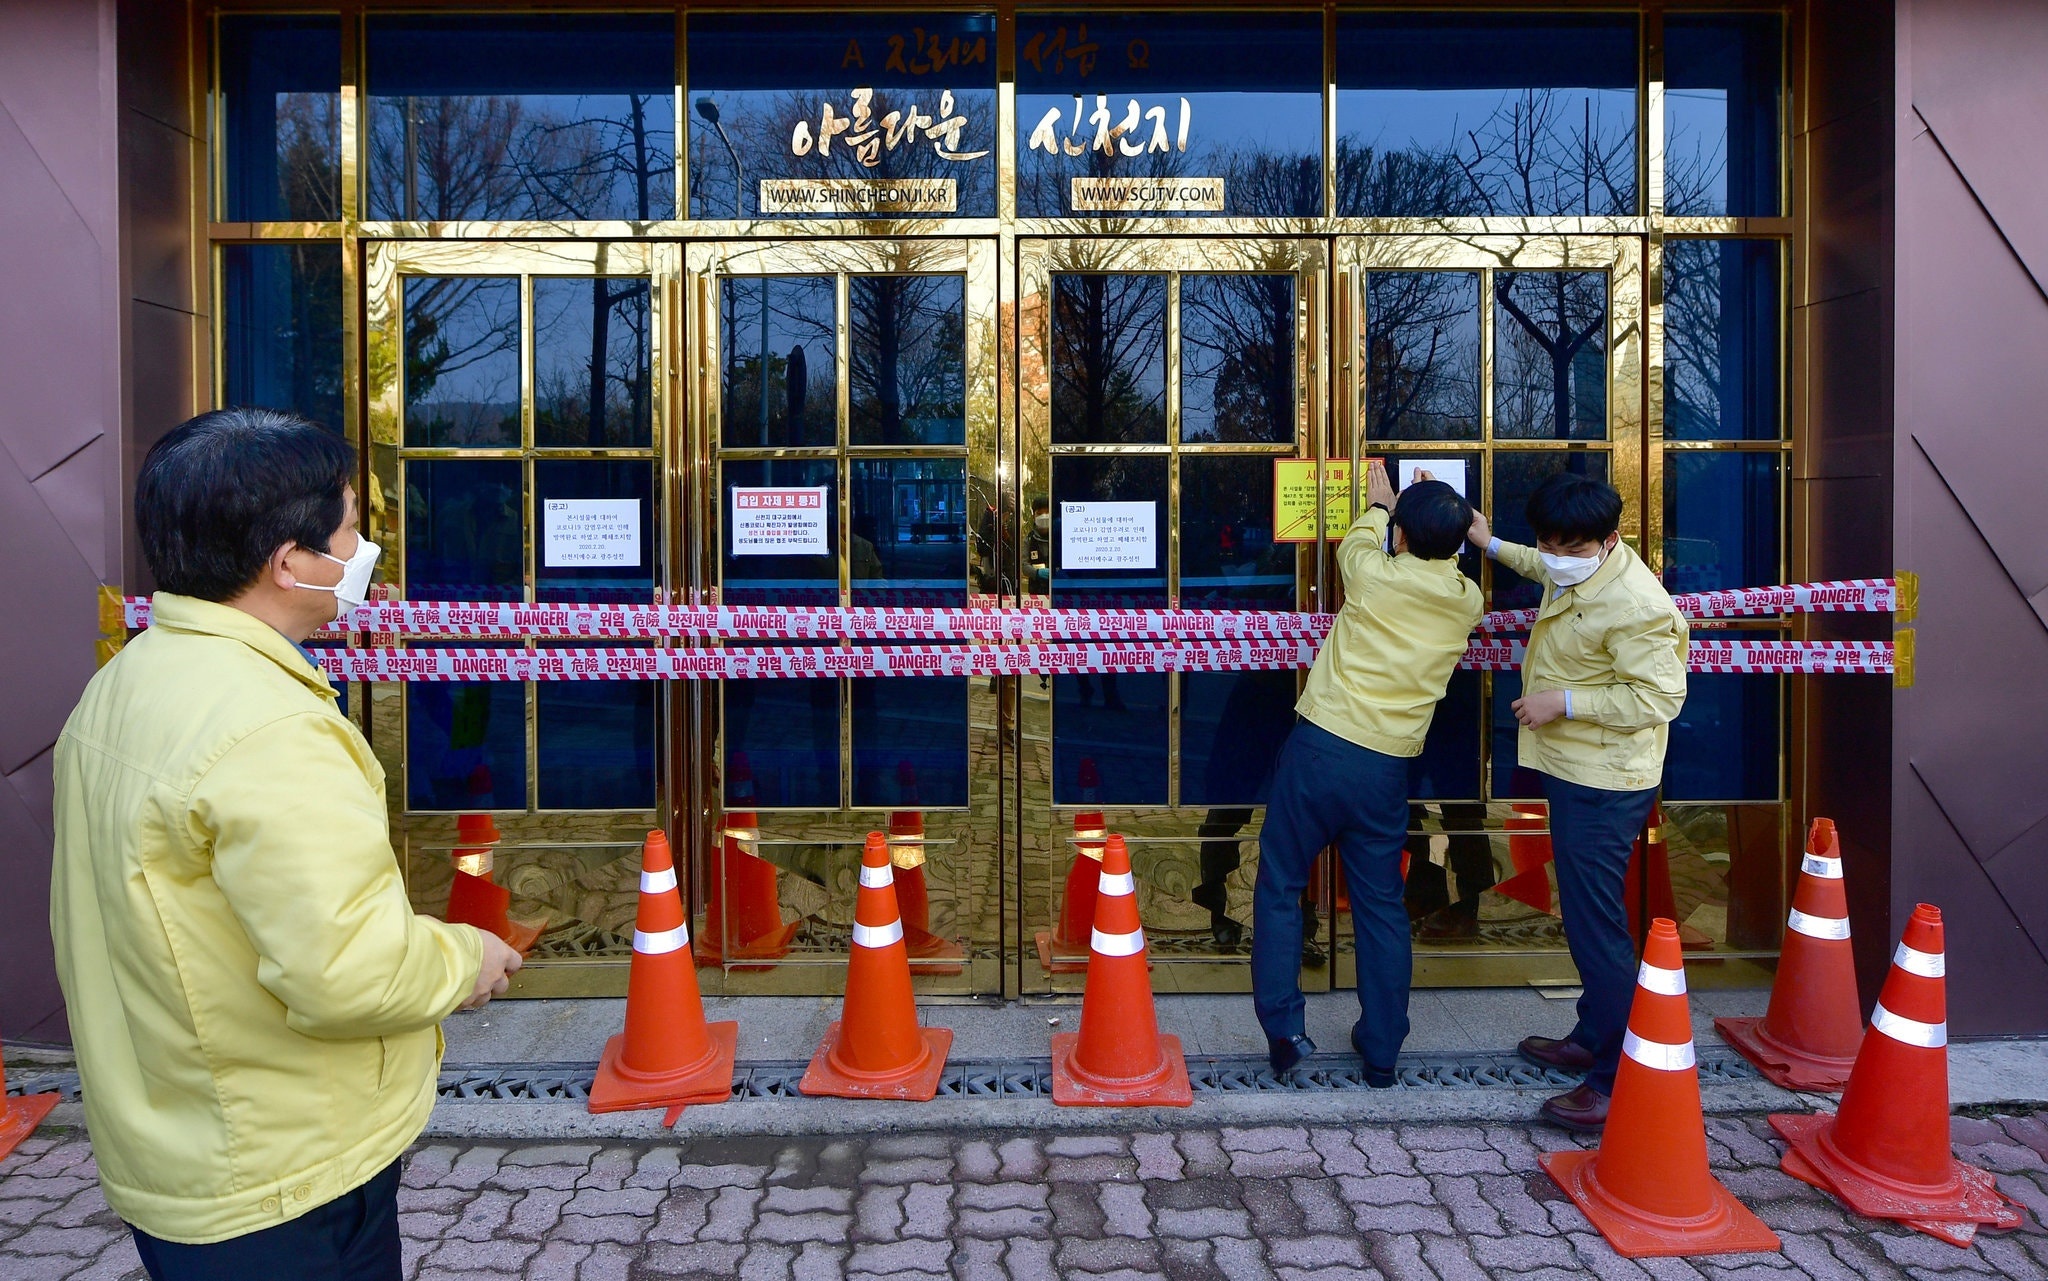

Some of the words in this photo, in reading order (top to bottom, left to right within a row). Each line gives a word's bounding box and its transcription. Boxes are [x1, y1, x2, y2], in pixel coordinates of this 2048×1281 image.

[791, 86, 990, 168] 아름다운
[1029, 91, 1191, 157] 신천지
[770, 187, 948, 204] WWW.SHINCHEONJI.KR
[1081, 186, 1216, 202] WWW.SCJTV.COM
[548, 502, 569, 511] (공고)
[739, 495, 758, 507] 출입
[762, 495, 782, 506] 자제
[785, 495, 795, 507] 및
[798, 495, 818, 506] 통제
[1065, 505, 1086, 513] (공고)
[1675, 598, 1701, 612] 위험
[1744, 590, 1796, 607] 안전제일
[1810, 588, 1866, 604] DANGER!
[379, 608, 405, 624] 위험
[447, 609, 499, 626] 안전제일
[514, 611, 569, 627] DANGER!
[600, 612, 625, 628] 위험
[667, 612, 719, 629] 안전제일
[733, 613, 787, 629] DANGER!
[817, 614, 843, 630] 위험
[884, 614, 935, 631] 안전제일
[949, 615, 1002, 631] DANGER!
[1032, 615, 1058, 631] 위험
[1098, 615, 1148, 631] 안전제일
[1162, 615, 1215, 631] DANGER!
[1244, 614, 1269, 630] 위험
[386, 658, 438, 674] 안전제일
[452, 658, 508, 673] DANGER!
[538, 657, 564, 673] 위험
[606, 657, 657, 672] 안전제일
[672, 656, 726, 672] DANGER!
[757, 656, 782, 671] 위험
[824, 655, 875, 671] 안전제일
[888, 655, 942, 669] DANGER!
[972, 653, 997, 668] 위험
[1038, 652, 1088, 667] 안전제일
[1102, 651, 1155, 666] DANGER!
[1184, 650, 1209, 665] 위험
[1250, 647, 1298, 663] 안전제일
[1747, 650, 1803, 666] DANGER!
[1835, 650, 1861, 665] 위험
